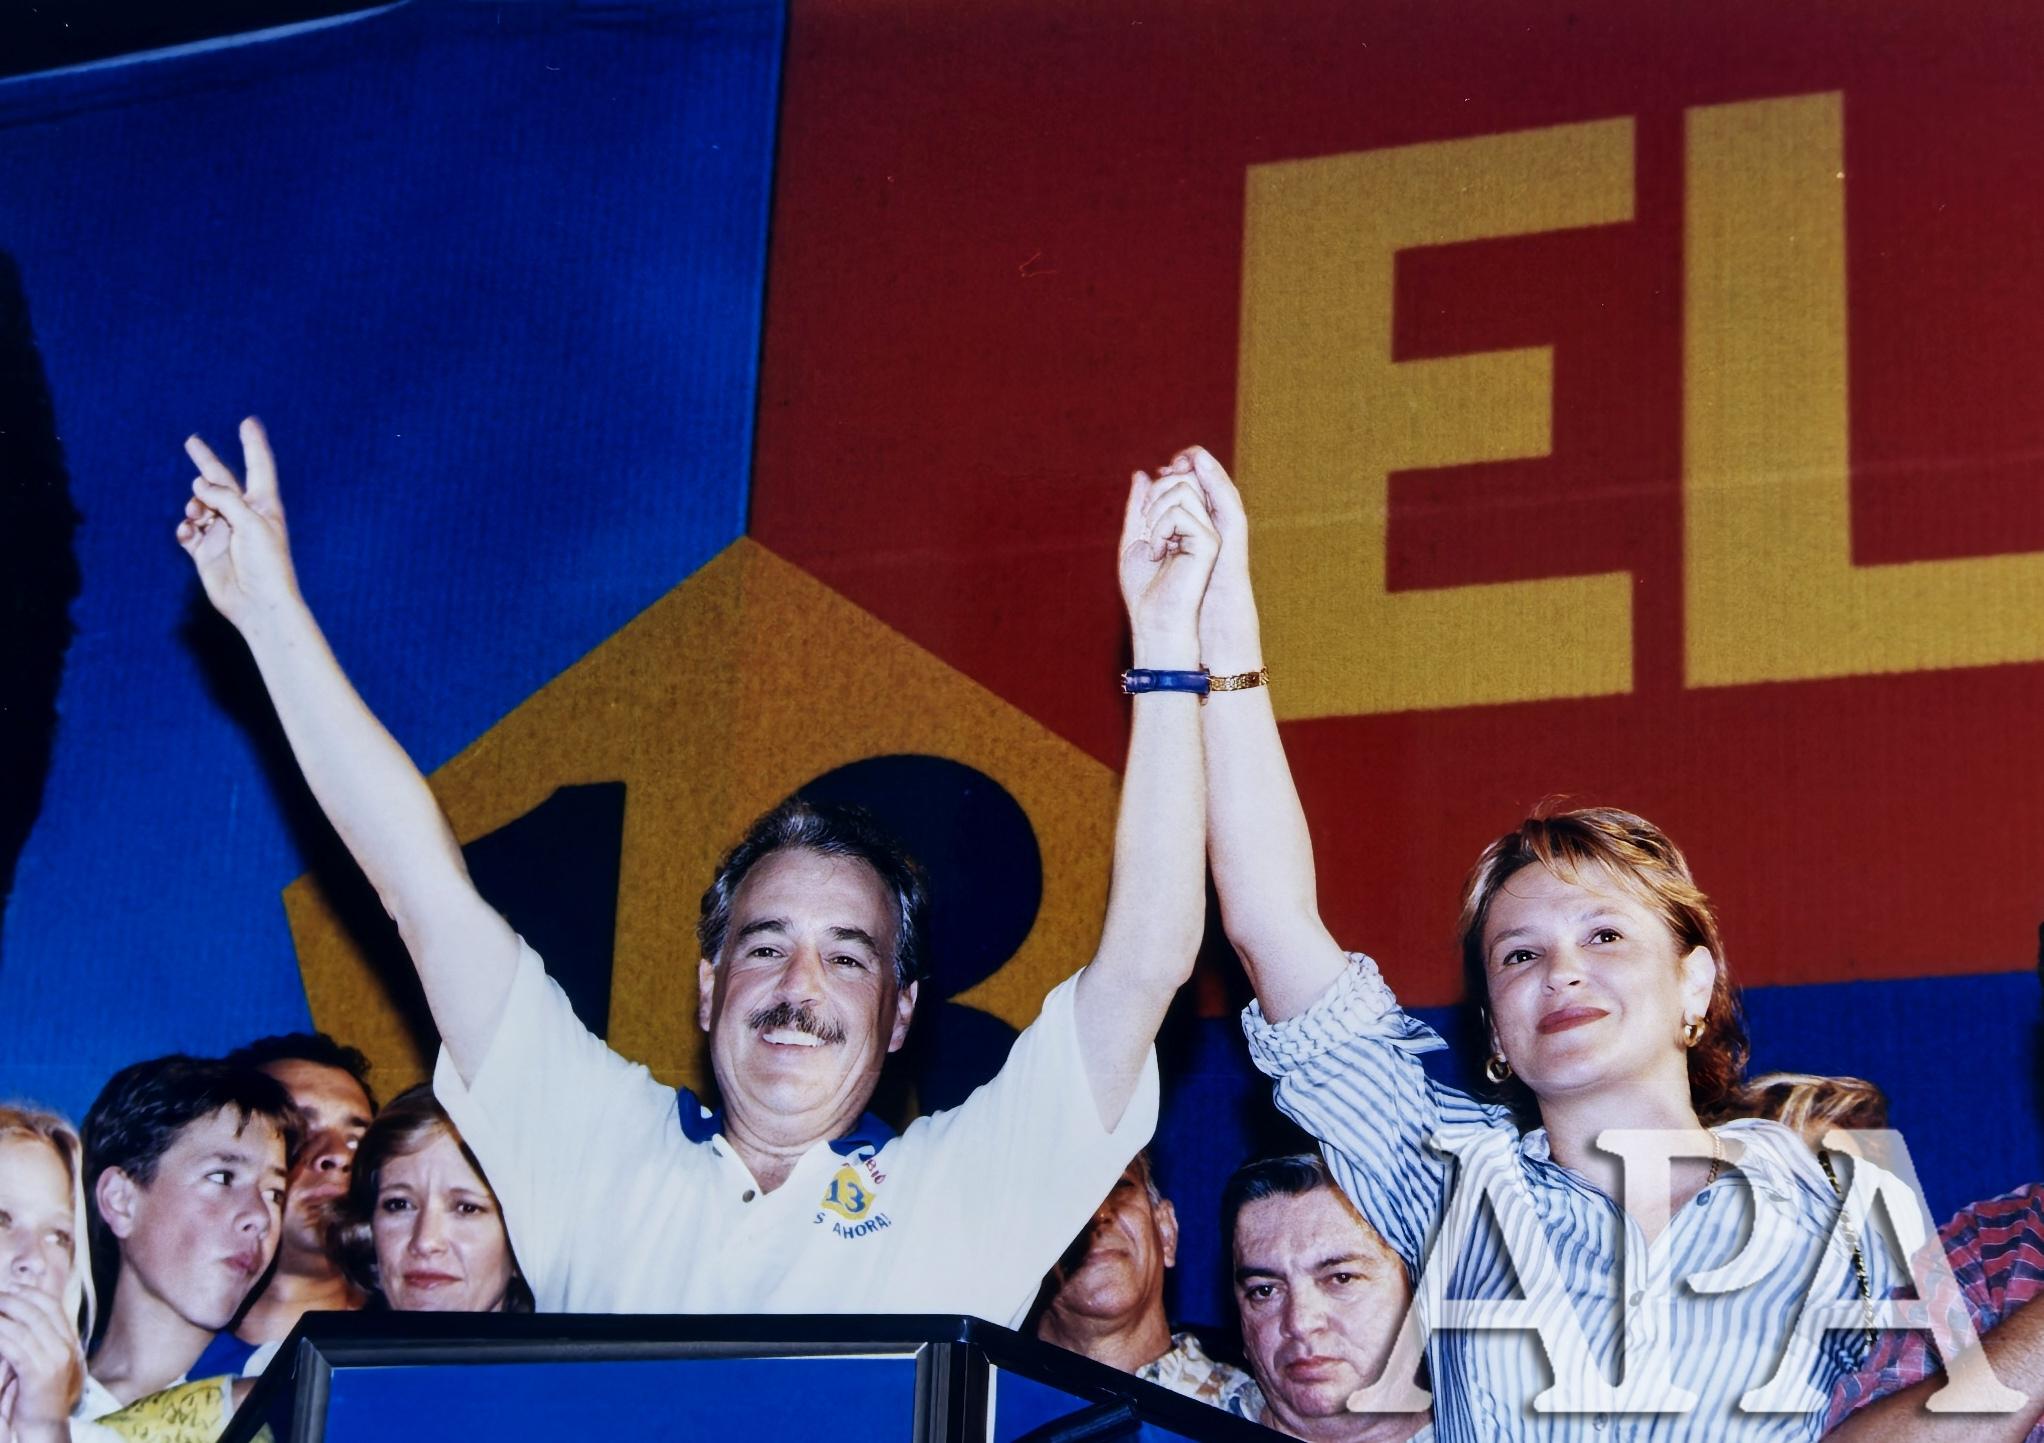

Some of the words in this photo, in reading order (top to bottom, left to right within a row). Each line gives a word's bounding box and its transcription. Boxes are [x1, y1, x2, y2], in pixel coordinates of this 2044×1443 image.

[1233, 91, 2044, 722] EL
[826, 1179, 866, 1213] 13
[833, 1213, 892, 1239] AHORA!
